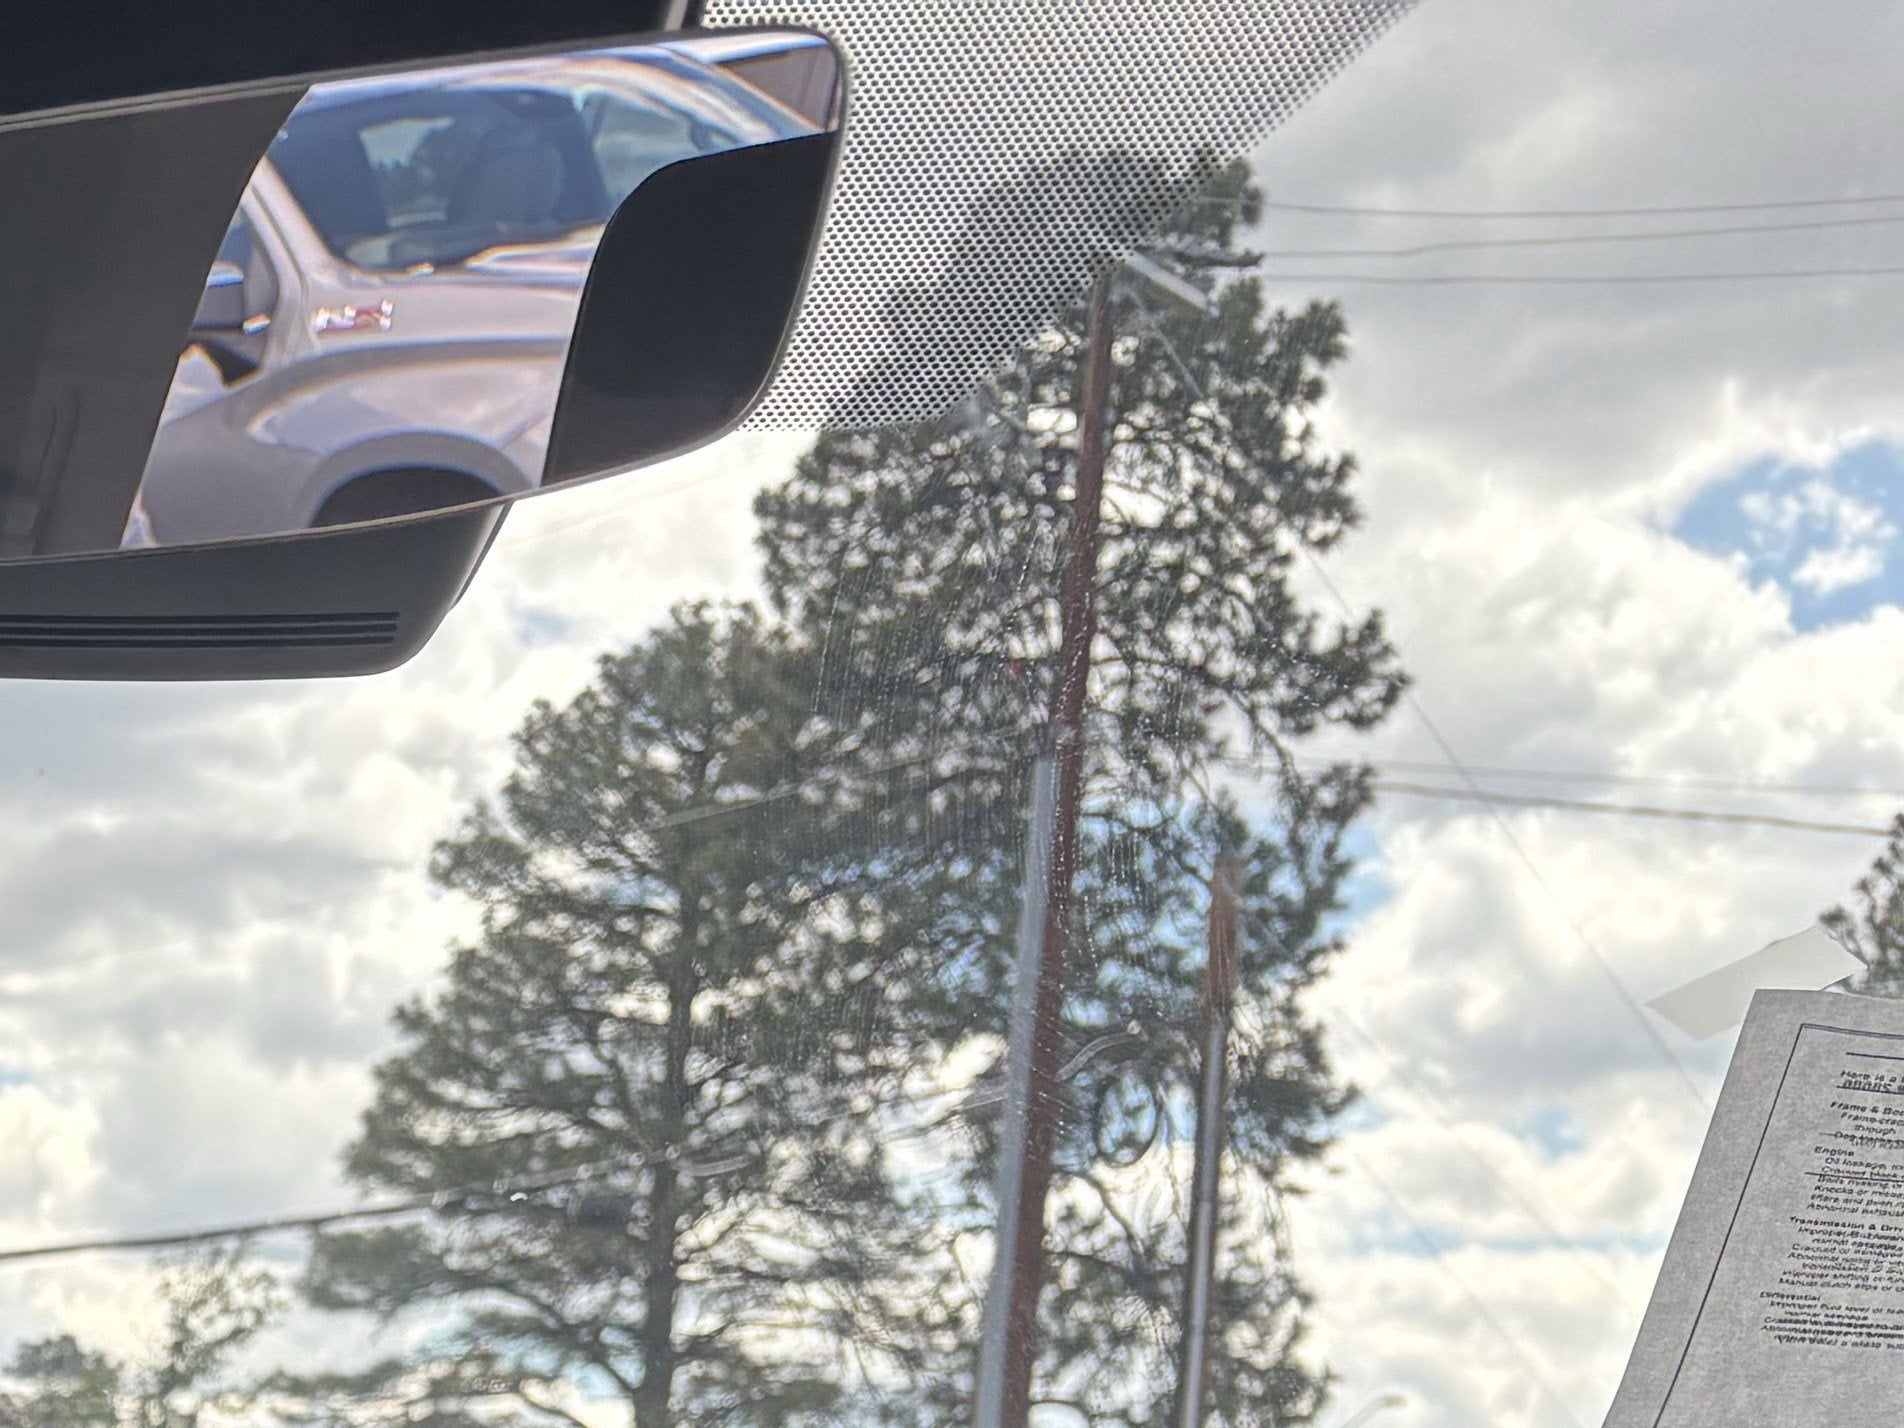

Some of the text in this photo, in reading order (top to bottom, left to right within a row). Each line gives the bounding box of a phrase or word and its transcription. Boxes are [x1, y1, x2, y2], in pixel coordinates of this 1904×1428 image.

[1831, 1101, 1867, 1112] Frame
[1814, 1146, 1854, 1157] Engine
[1790, 1216, 1865, 1229] Transmission
